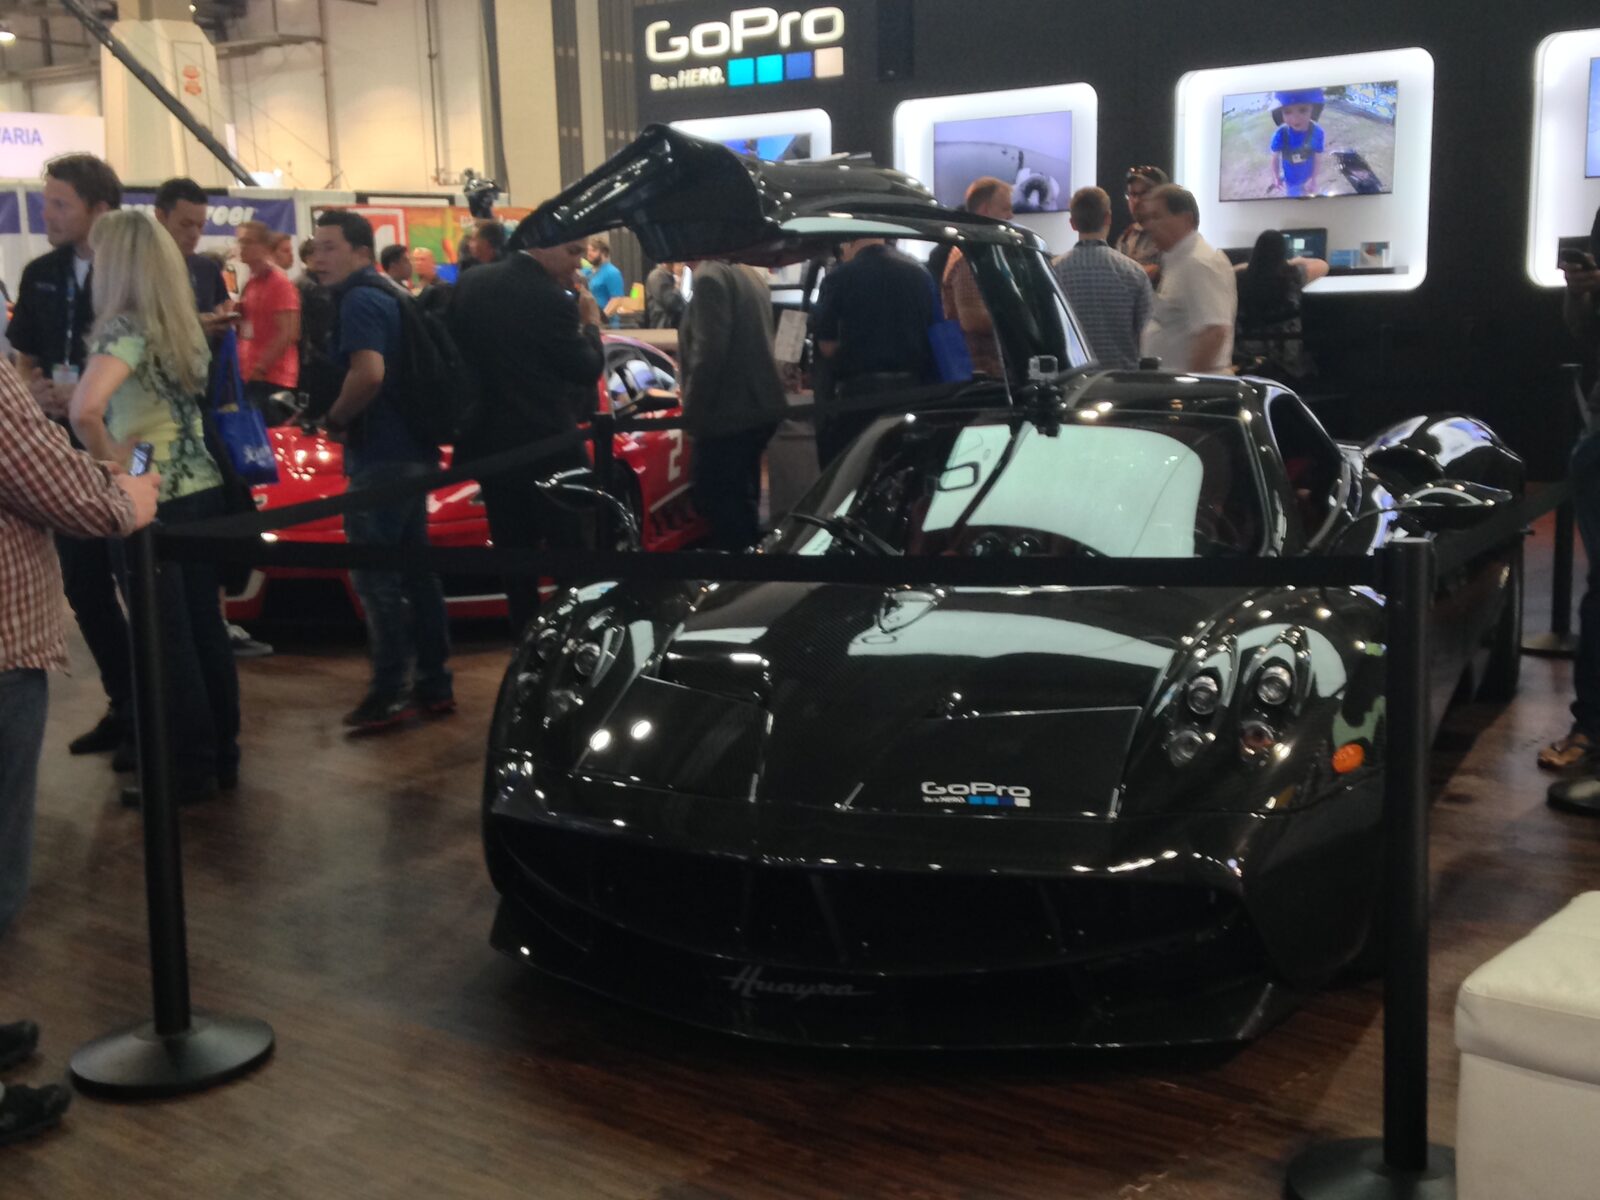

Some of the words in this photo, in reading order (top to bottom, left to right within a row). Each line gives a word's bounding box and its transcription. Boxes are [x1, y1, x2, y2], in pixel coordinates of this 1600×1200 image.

[645, 6, 845, 63] GoPro
[0, 127, 43, 146] ARIA
[667, 429, 682, 482] 2
[921, 781, 1031, 797] GoPro
[718, 965, 877, 1000] Huayra
